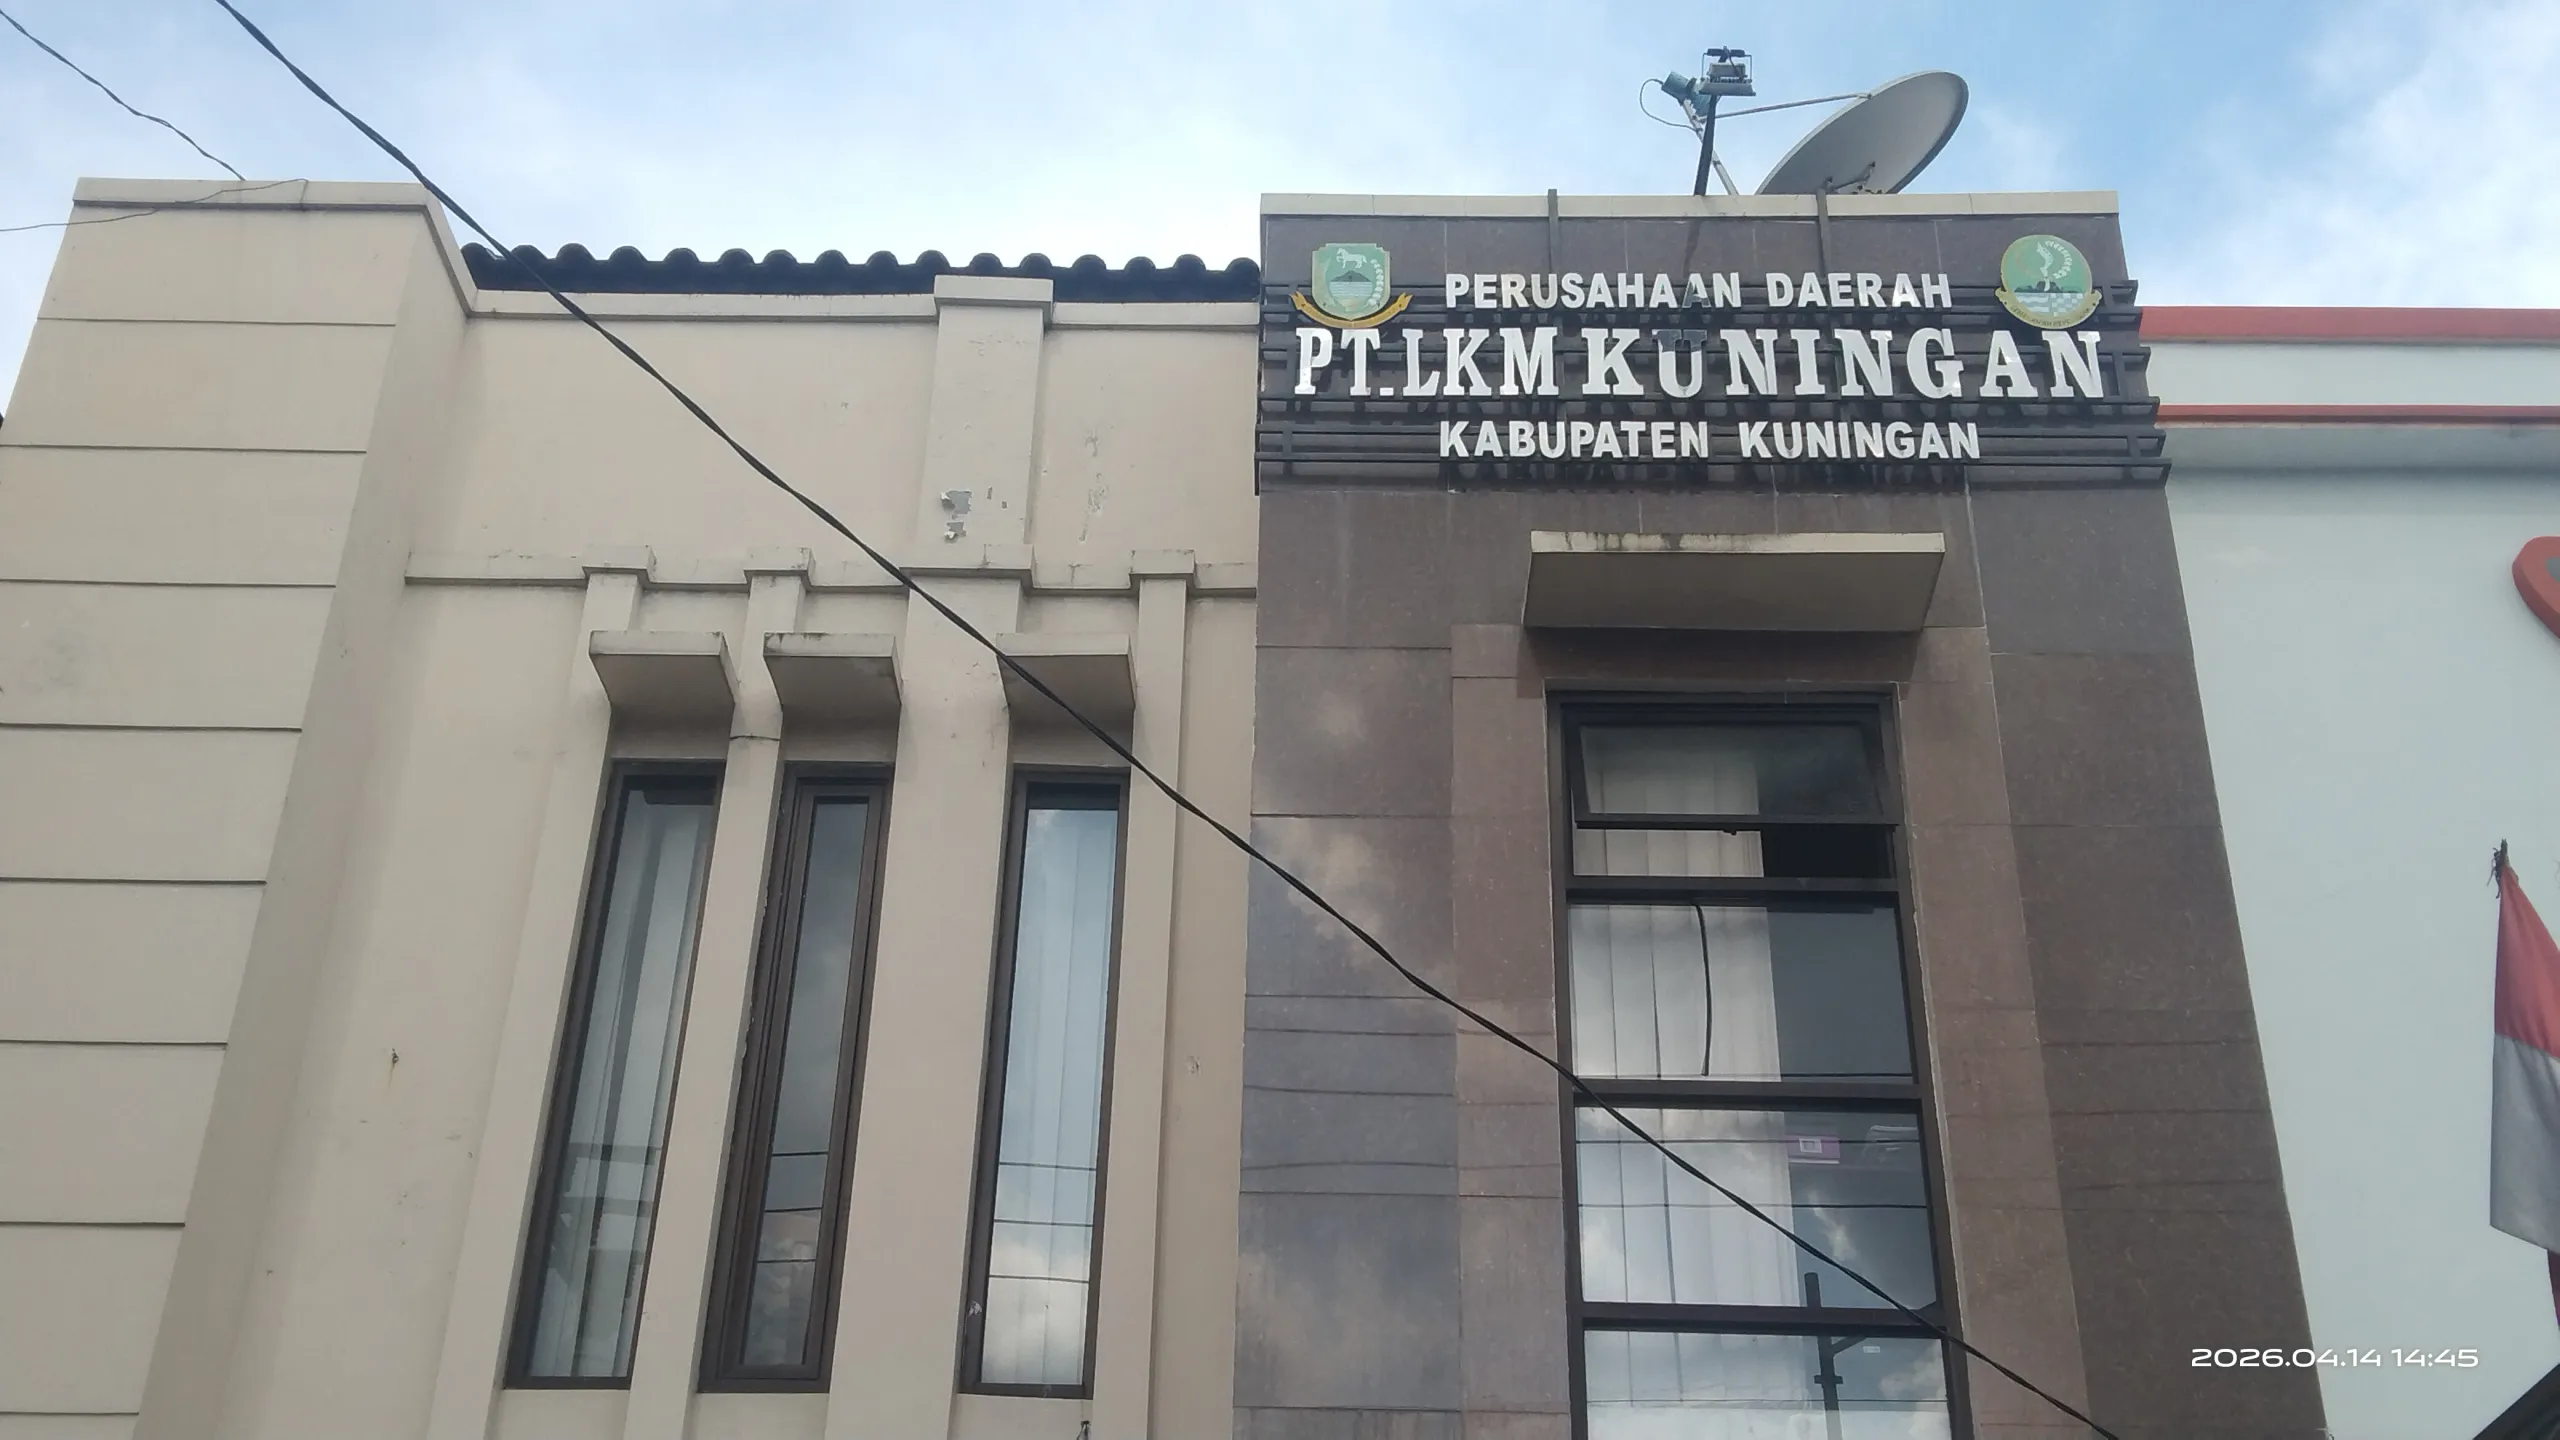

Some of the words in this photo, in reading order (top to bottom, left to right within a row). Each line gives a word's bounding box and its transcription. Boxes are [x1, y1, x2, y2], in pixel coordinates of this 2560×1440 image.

[1445, 273, 1742, 308] PERUSAHAAN
[1766, 272, 1953, 308] DAERAH
[1581, 327, 2104, 398] KUNINGAN
[1439, 420, 1709, 459] KABUPATEN
[1738, 421, 1981, 460] KUNINGAN
